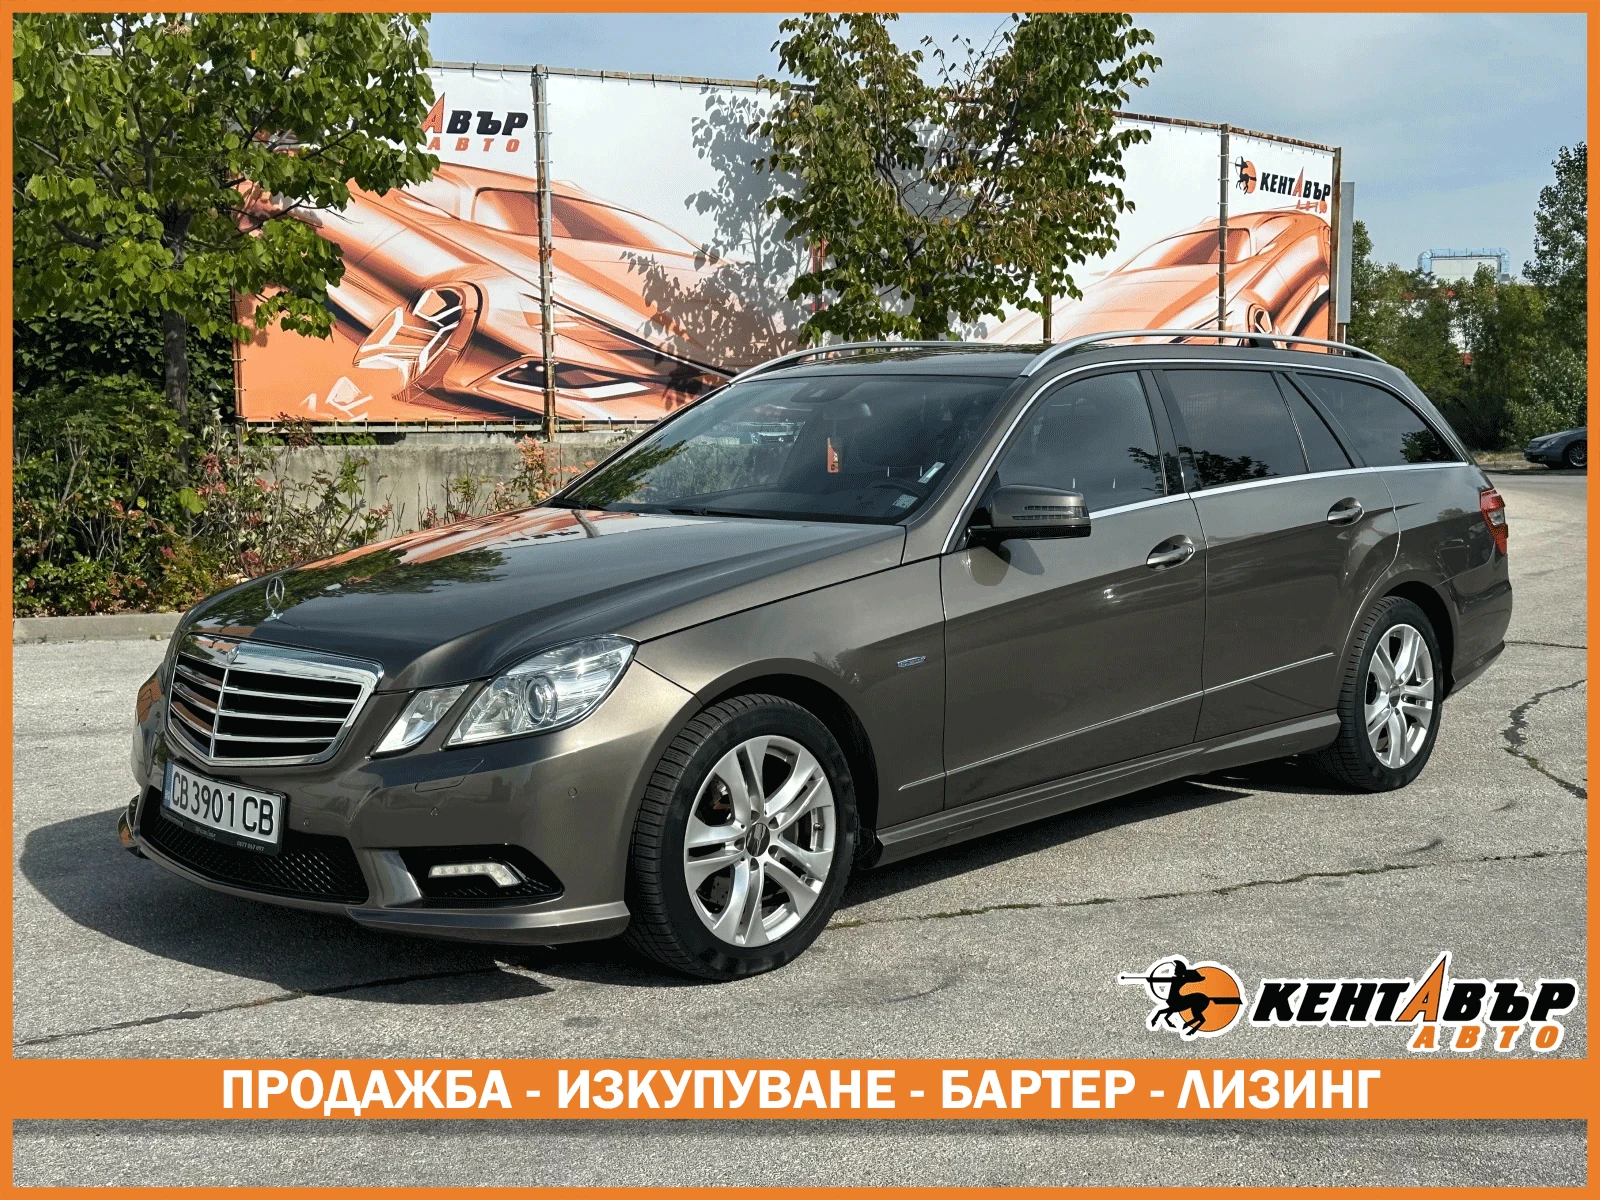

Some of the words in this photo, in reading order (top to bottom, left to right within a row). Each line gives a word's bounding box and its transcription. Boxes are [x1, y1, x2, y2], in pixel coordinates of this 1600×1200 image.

[420, 91, 529, 136] АВЪР
[426, 136, 521, 153] АВТО
[1259, 165, 1332, 202] КЕНТАВЪР
